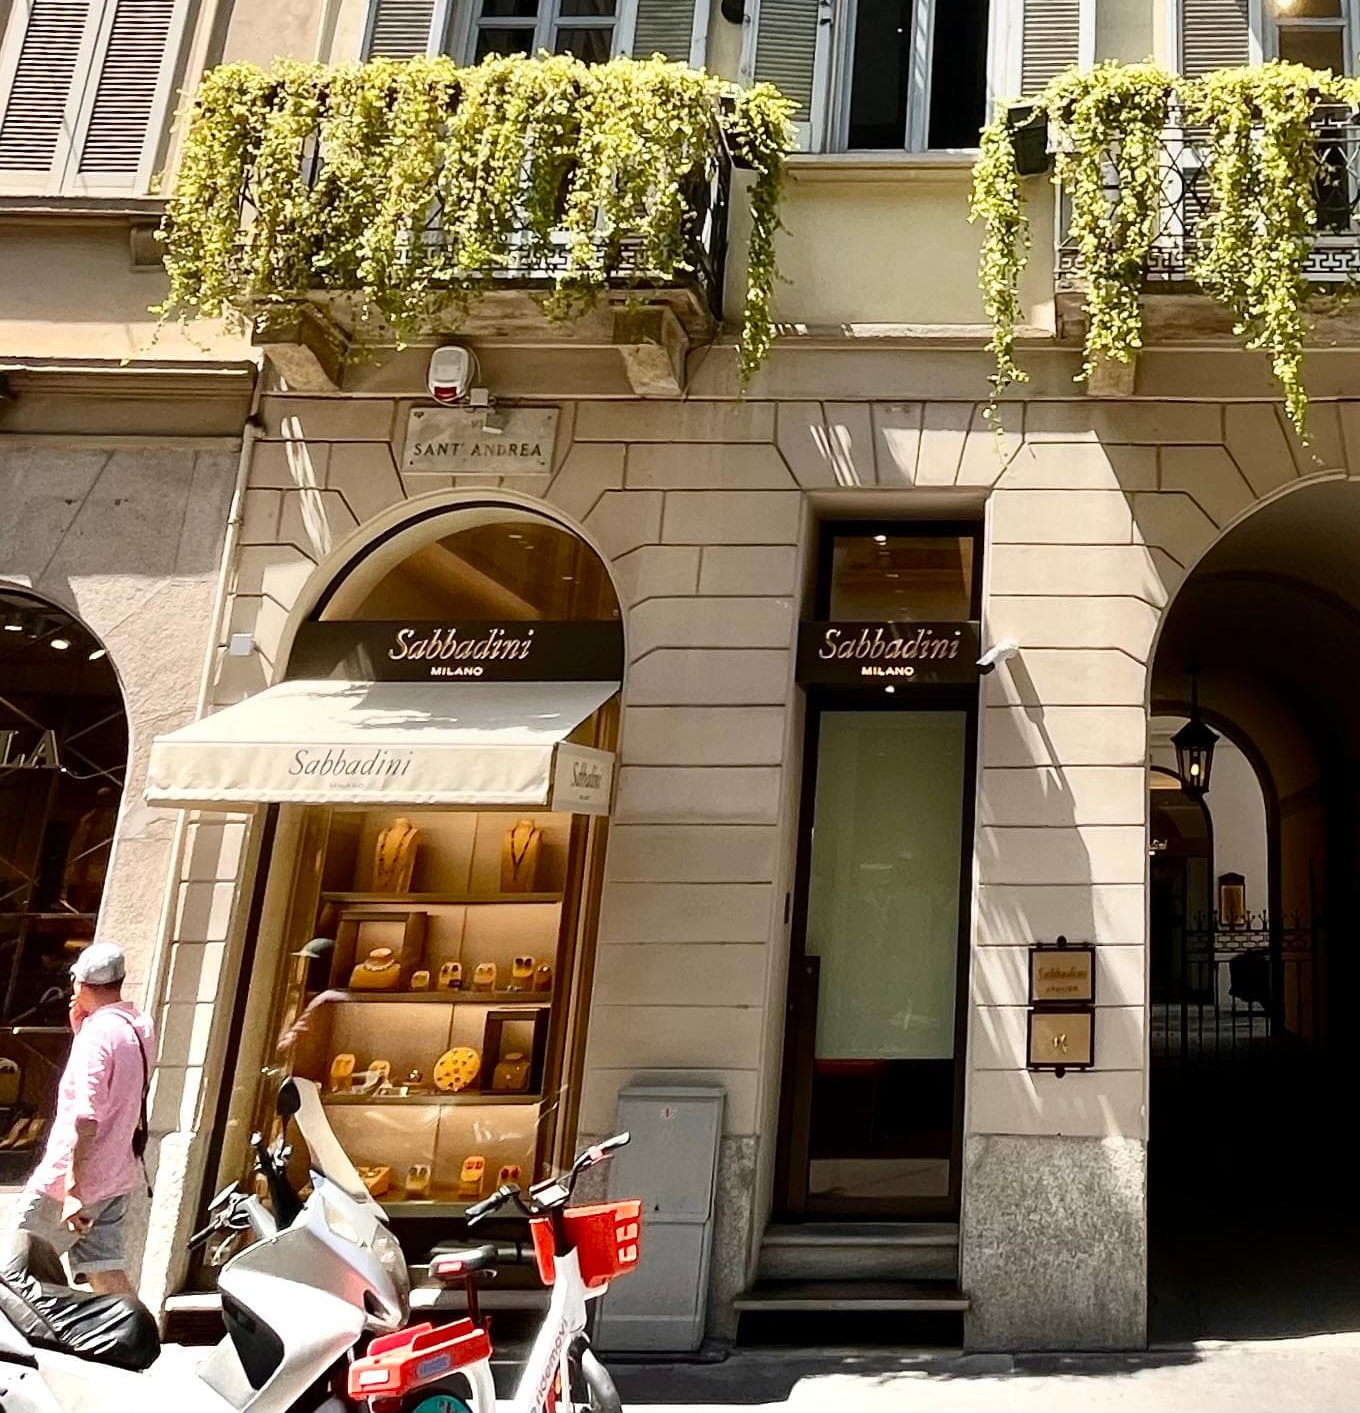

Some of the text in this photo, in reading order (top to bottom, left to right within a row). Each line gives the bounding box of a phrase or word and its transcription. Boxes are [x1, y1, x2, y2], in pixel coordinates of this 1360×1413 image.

[470, 443, 542, 456] ANDREA
[388, 628, 535, 660] Sabbadini
[818, 628, 961, 660] Sabbadini
[430, 666, 484, 676] MILANO
[861, 666, 914, 676] MILANO
[288, 748, 413, 776] Sabbadini
